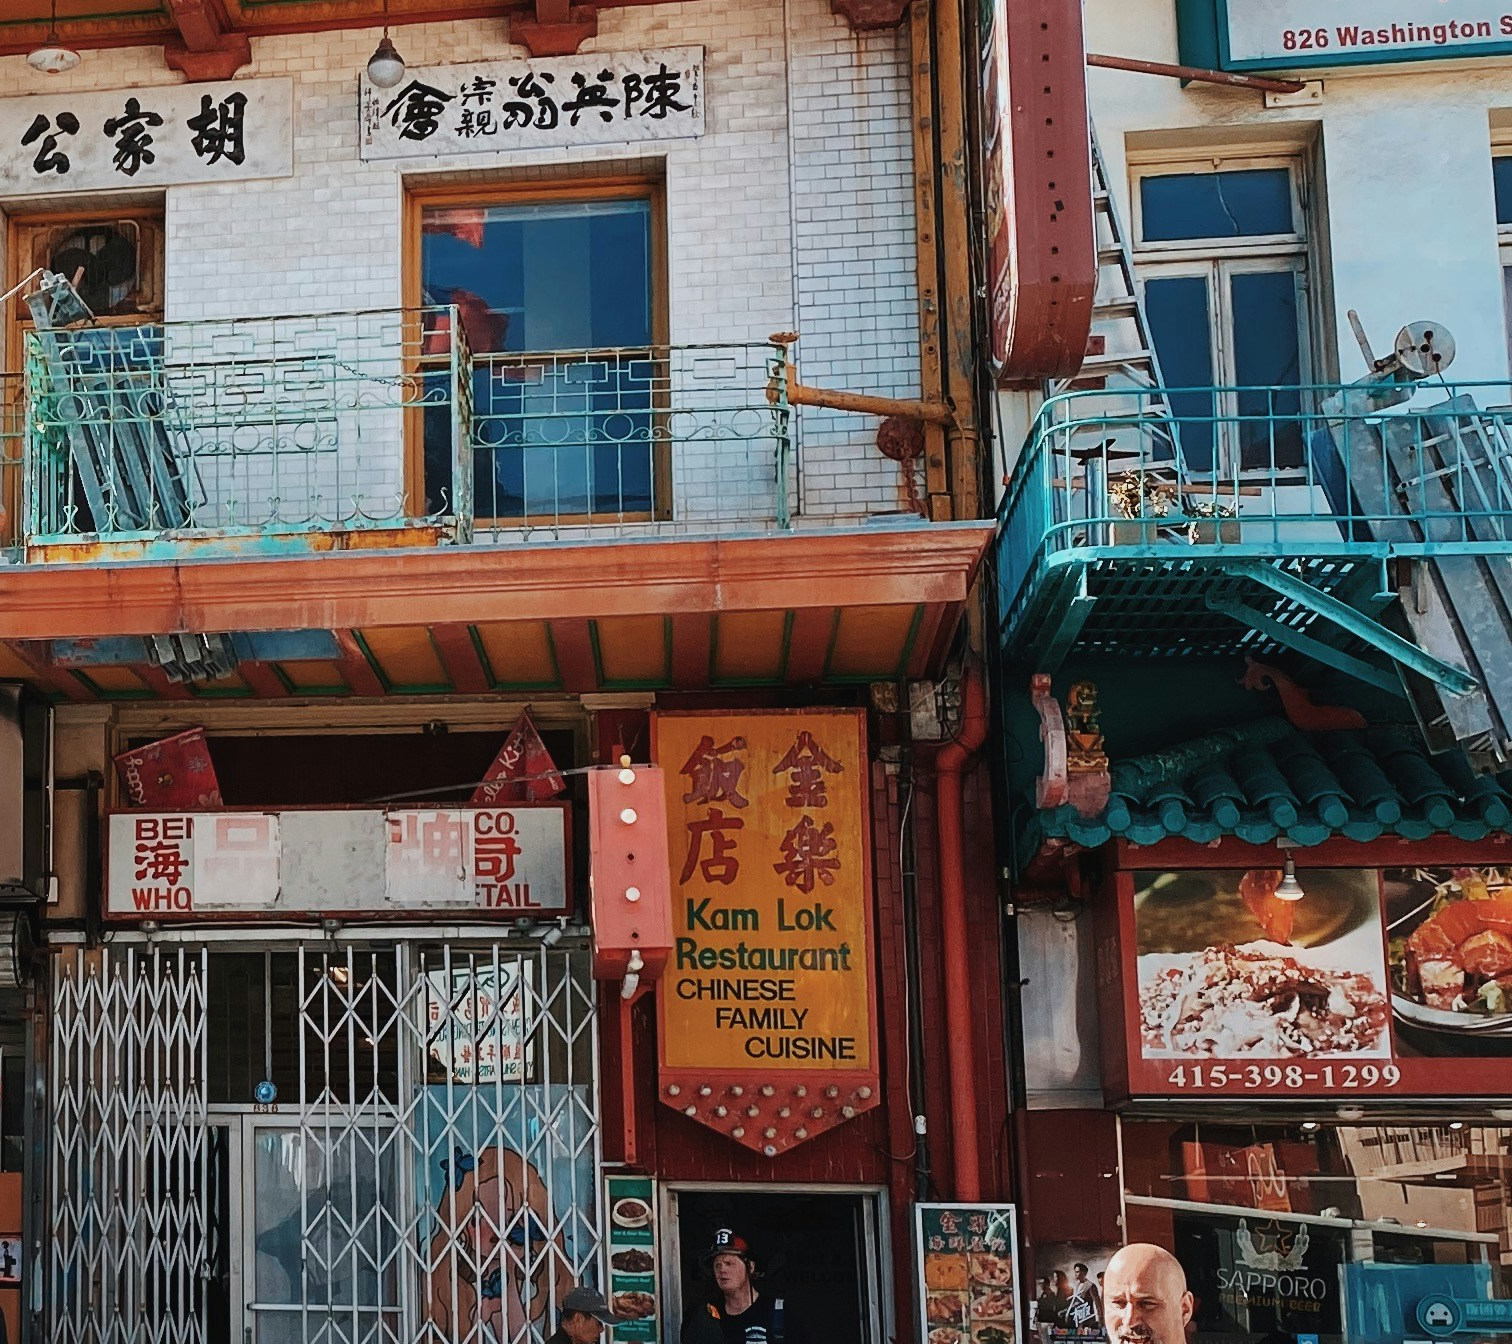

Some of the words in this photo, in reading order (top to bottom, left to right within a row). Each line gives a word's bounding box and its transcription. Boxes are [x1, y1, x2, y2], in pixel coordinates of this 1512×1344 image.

[1283, 28, 1329, 51] 826
[1336, 19, 1491, 47] Washington
[474, 812, 520, 835] CO.
[131, 887, 193, 910] WHO
[474, 884, 541, 908] TAIL
[686, 898, 759, 932] Kam
[778, 898, 836, 932] Lok
[675, 938, 852, 972] Restaurant
[676, 978, 796, 1002] CHINESE
[715, 1007, 808, 1031] FAMILY
[745, 1036, 856, 1060] CUISINE
[1169, 1063, 1402, 1091] 415-398-1299
[716, 1232, 729, 1244] 13
[1216, 1267, 1327, 1300] SAPPORO
